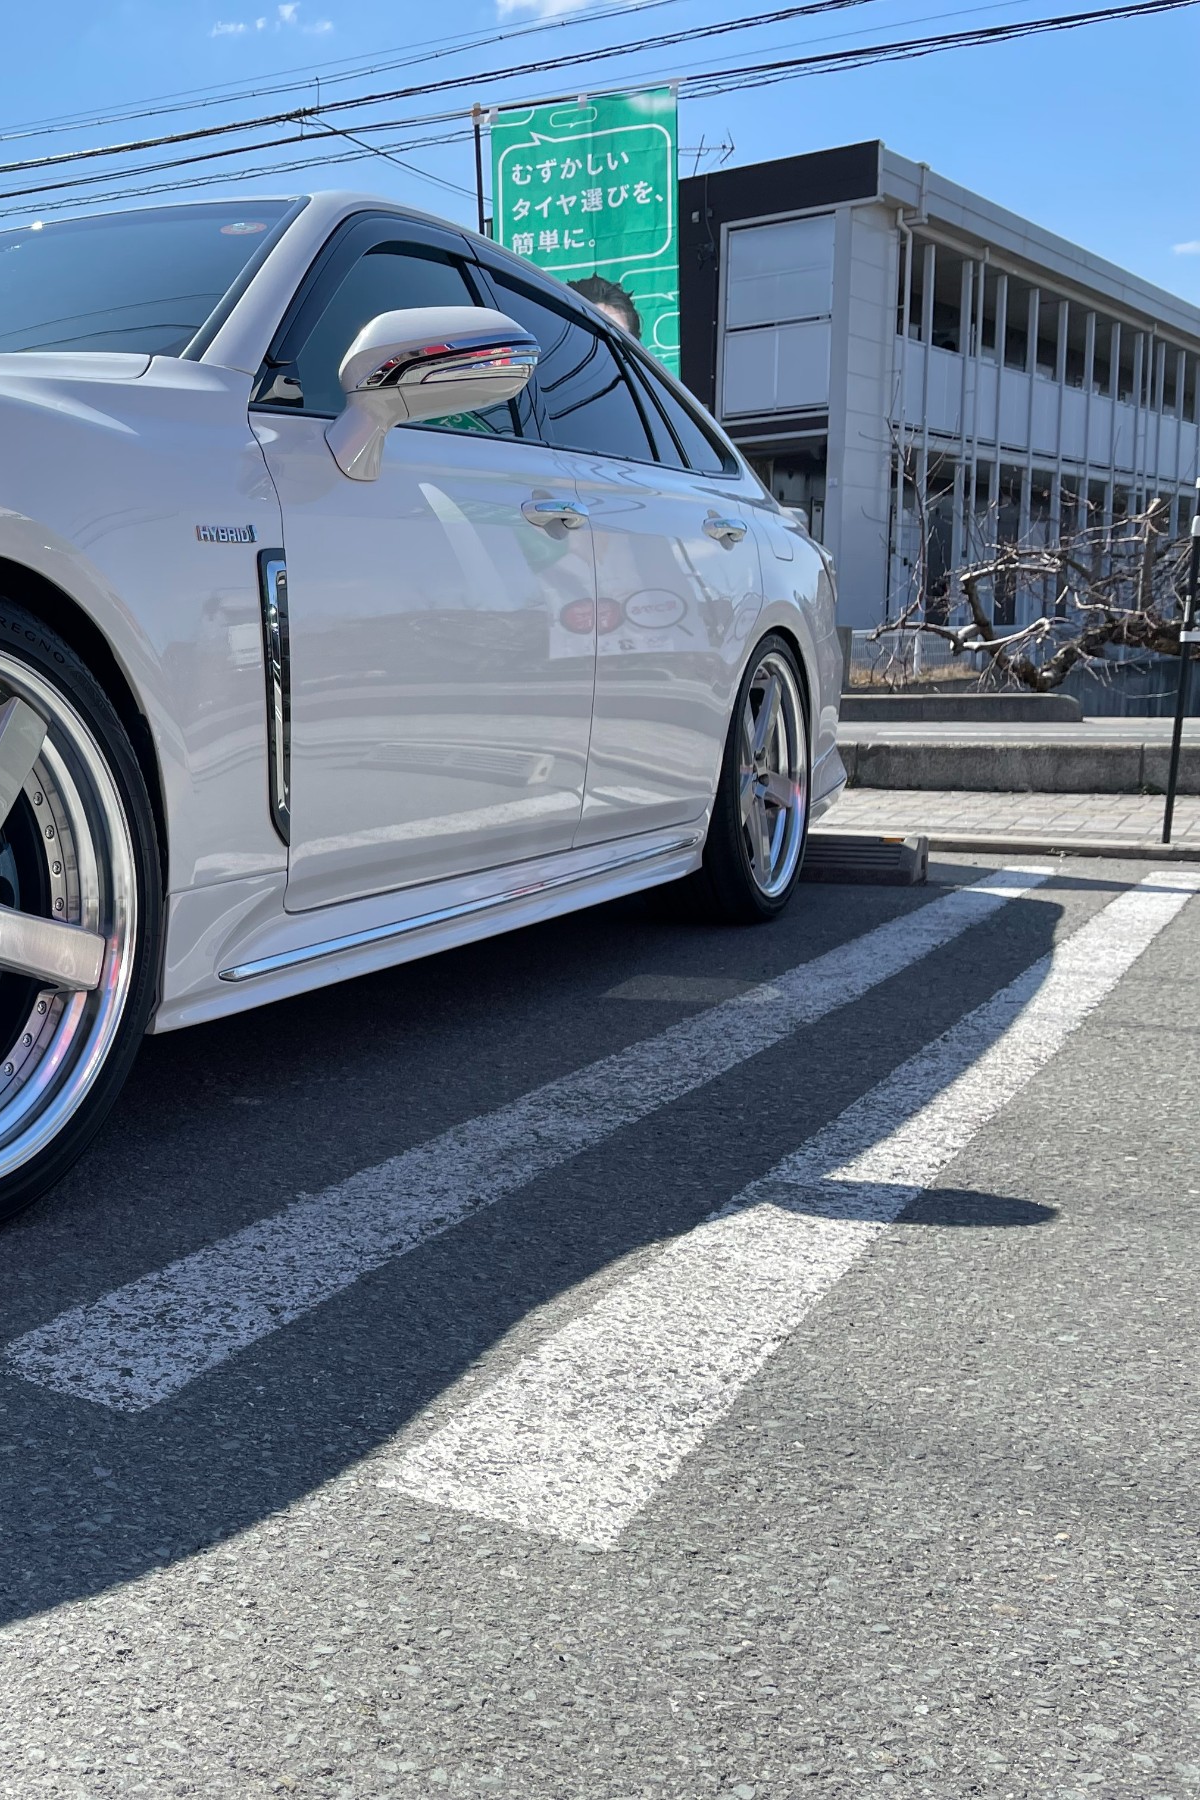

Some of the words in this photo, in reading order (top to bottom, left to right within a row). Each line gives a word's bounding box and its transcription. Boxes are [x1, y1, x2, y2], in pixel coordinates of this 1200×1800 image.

[511, 151, 629, 185] むずかしい
[511, 180, 664, 221] タイヤ選びを、
[511, 228, 598, 255] 簡単に。
[197, 525, 256, 542] HYBRID
